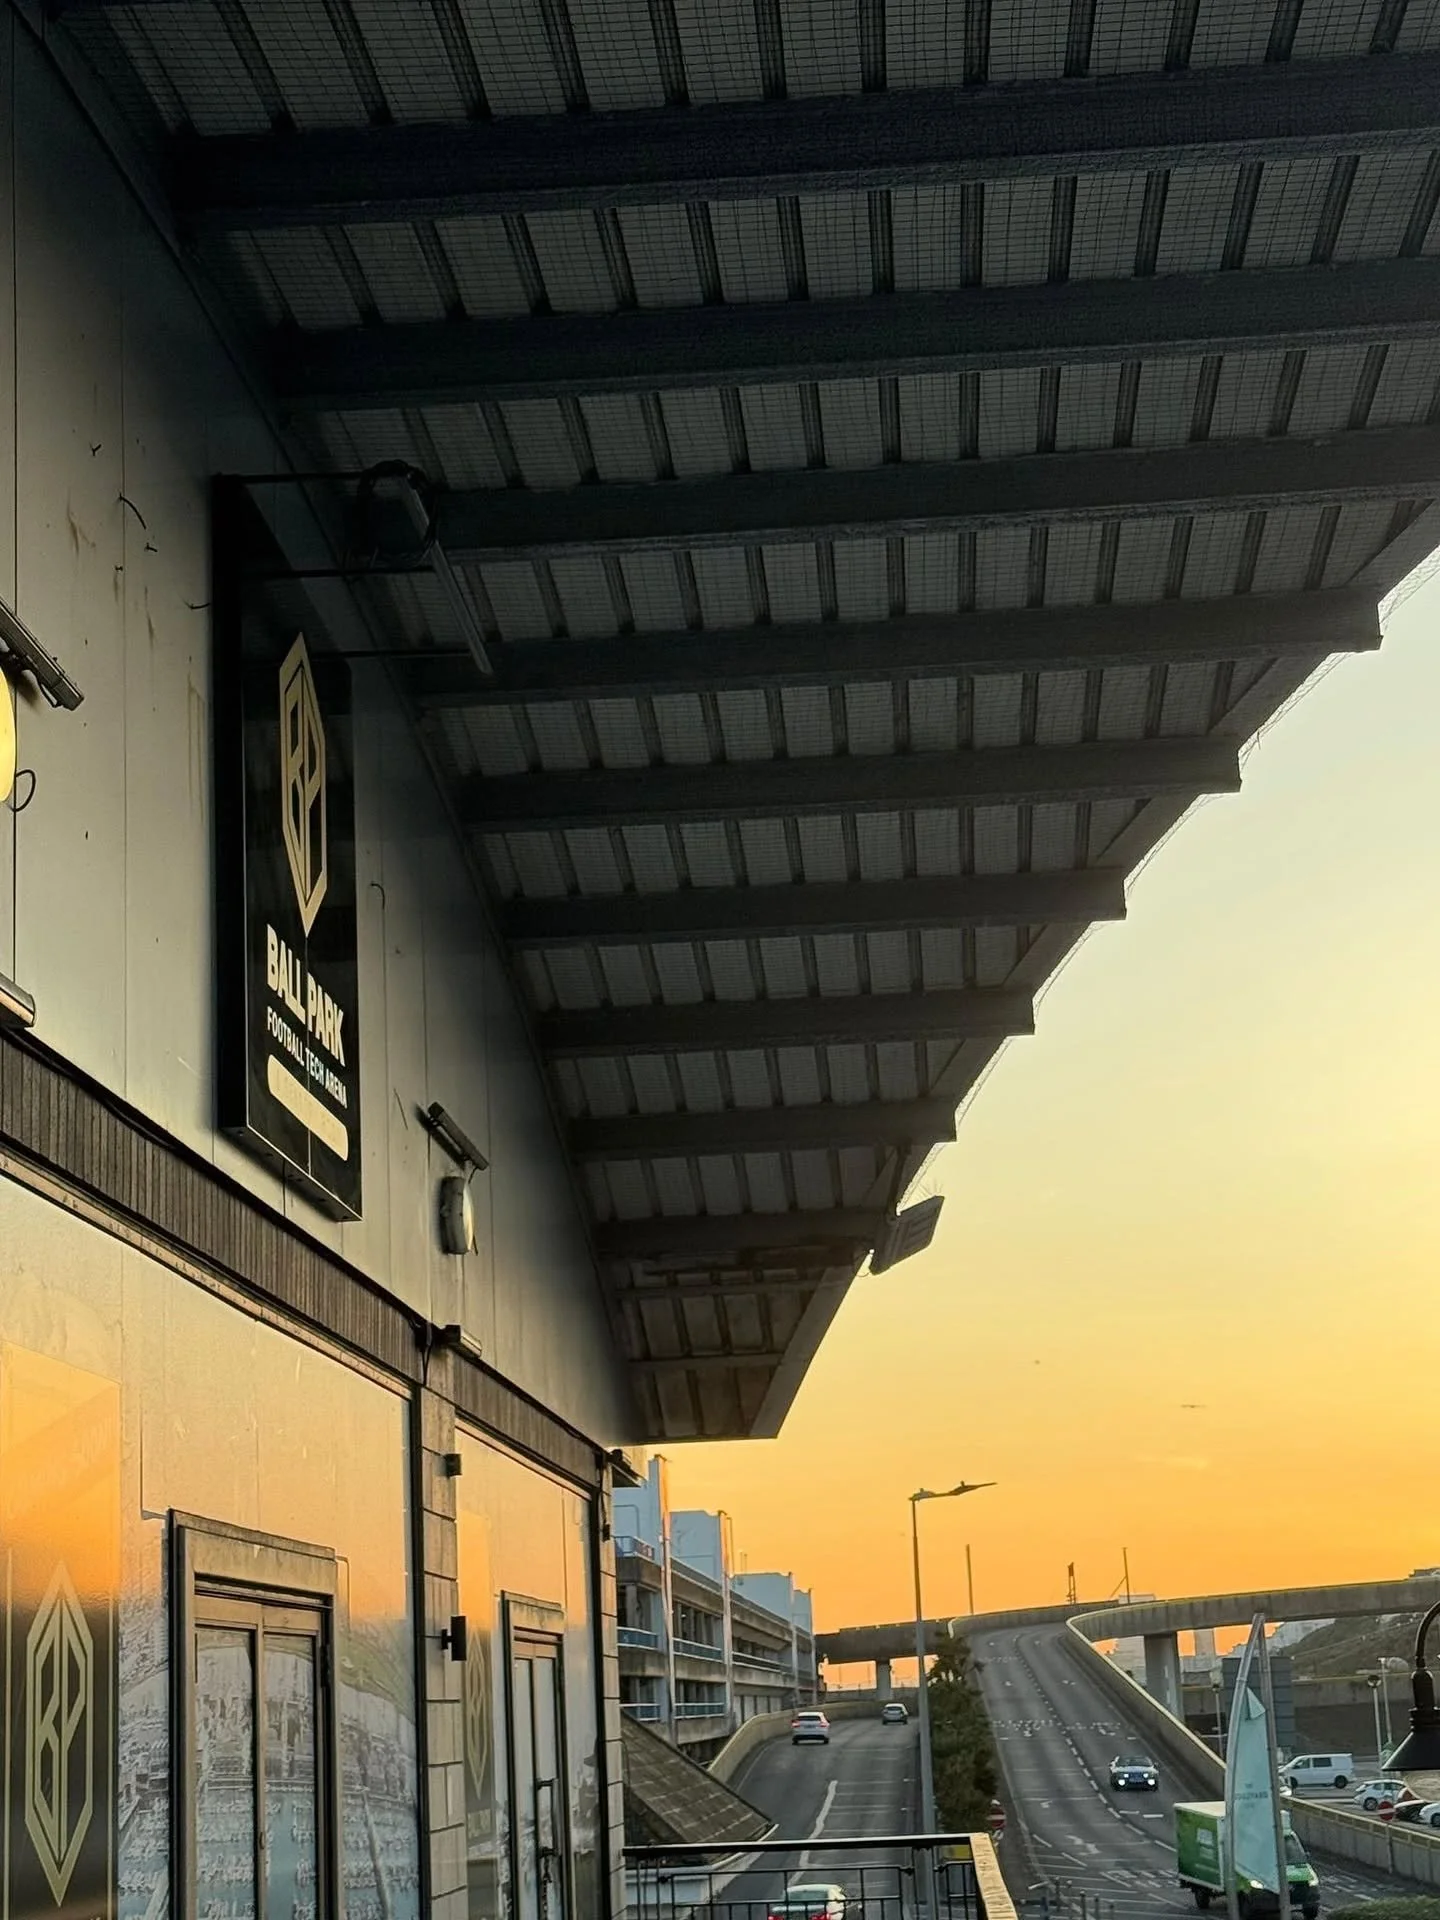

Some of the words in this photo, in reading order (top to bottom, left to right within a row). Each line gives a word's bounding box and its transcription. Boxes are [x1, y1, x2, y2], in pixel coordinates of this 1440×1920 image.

[266, 923, 306, 1025] BALL
[307, 971, 346, 1068] PARK
[266, 1005, 305, 1067] FOOTBALL
[305, 1047, 325, 1087] TECH
[324, 1067, 348, 1109] ARENA
